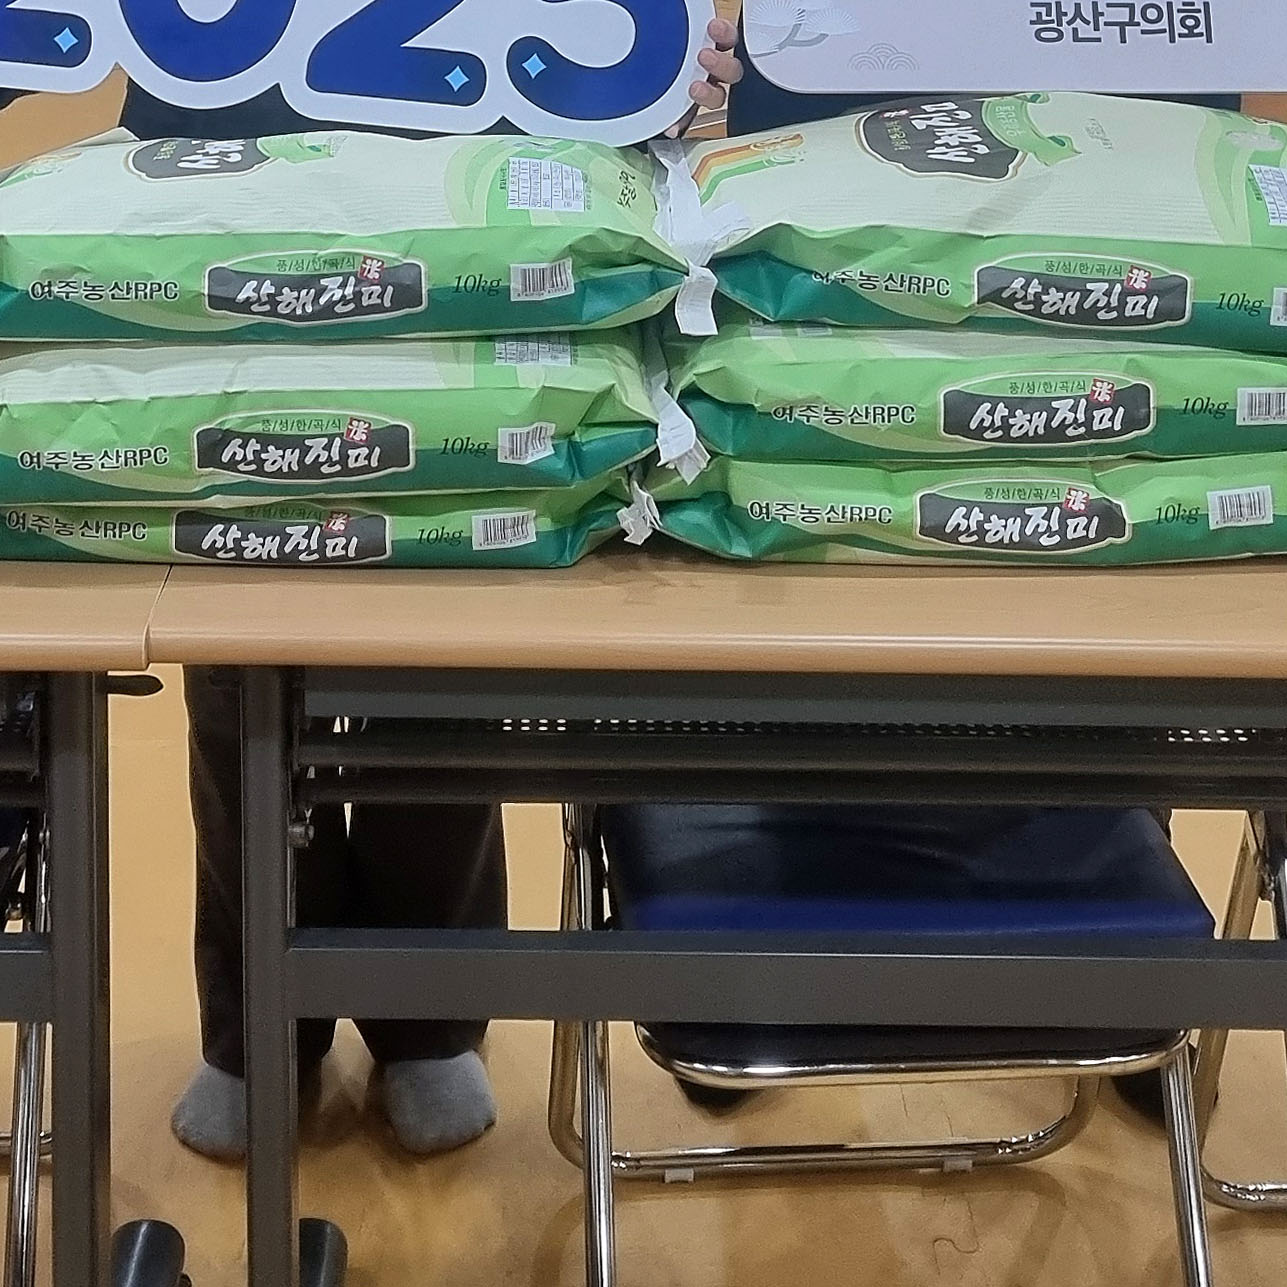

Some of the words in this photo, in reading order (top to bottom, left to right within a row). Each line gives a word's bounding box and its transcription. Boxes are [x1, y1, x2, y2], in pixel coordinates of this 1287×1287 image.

[1029, 0, 1213, 44] 광산구의회
[31, 280, 178, 301] 여주농산RPC
[236, 275, 393, 315] 산해진미
[452, 274, 502, 297] 10kg
[1002, 277, 1159, 319] 산해진미
[1216, 292, 1264, 317] 10kg
[772, 405, 915, 425] 여주농산RPC
[969, 398, 1125, 440] 산해진미
[1181, 396, 1229, 420] 10kg
[19, 446, 169, 469] 여주농산RPC
[221, 437, 381, 473] 산해진미
[440, 436, 491, 460] 10kg
[7, 510, 148, 540] 여주농산RPC
[749, 500, 893, 525] 여주농산RPC
[1154, 502, 1201, 526] 10kg
[416, 526, 464, 546] 10kg
[945, 506, 1099, 547] 산해진미
[201, 523, 358, 562] 산해진미
